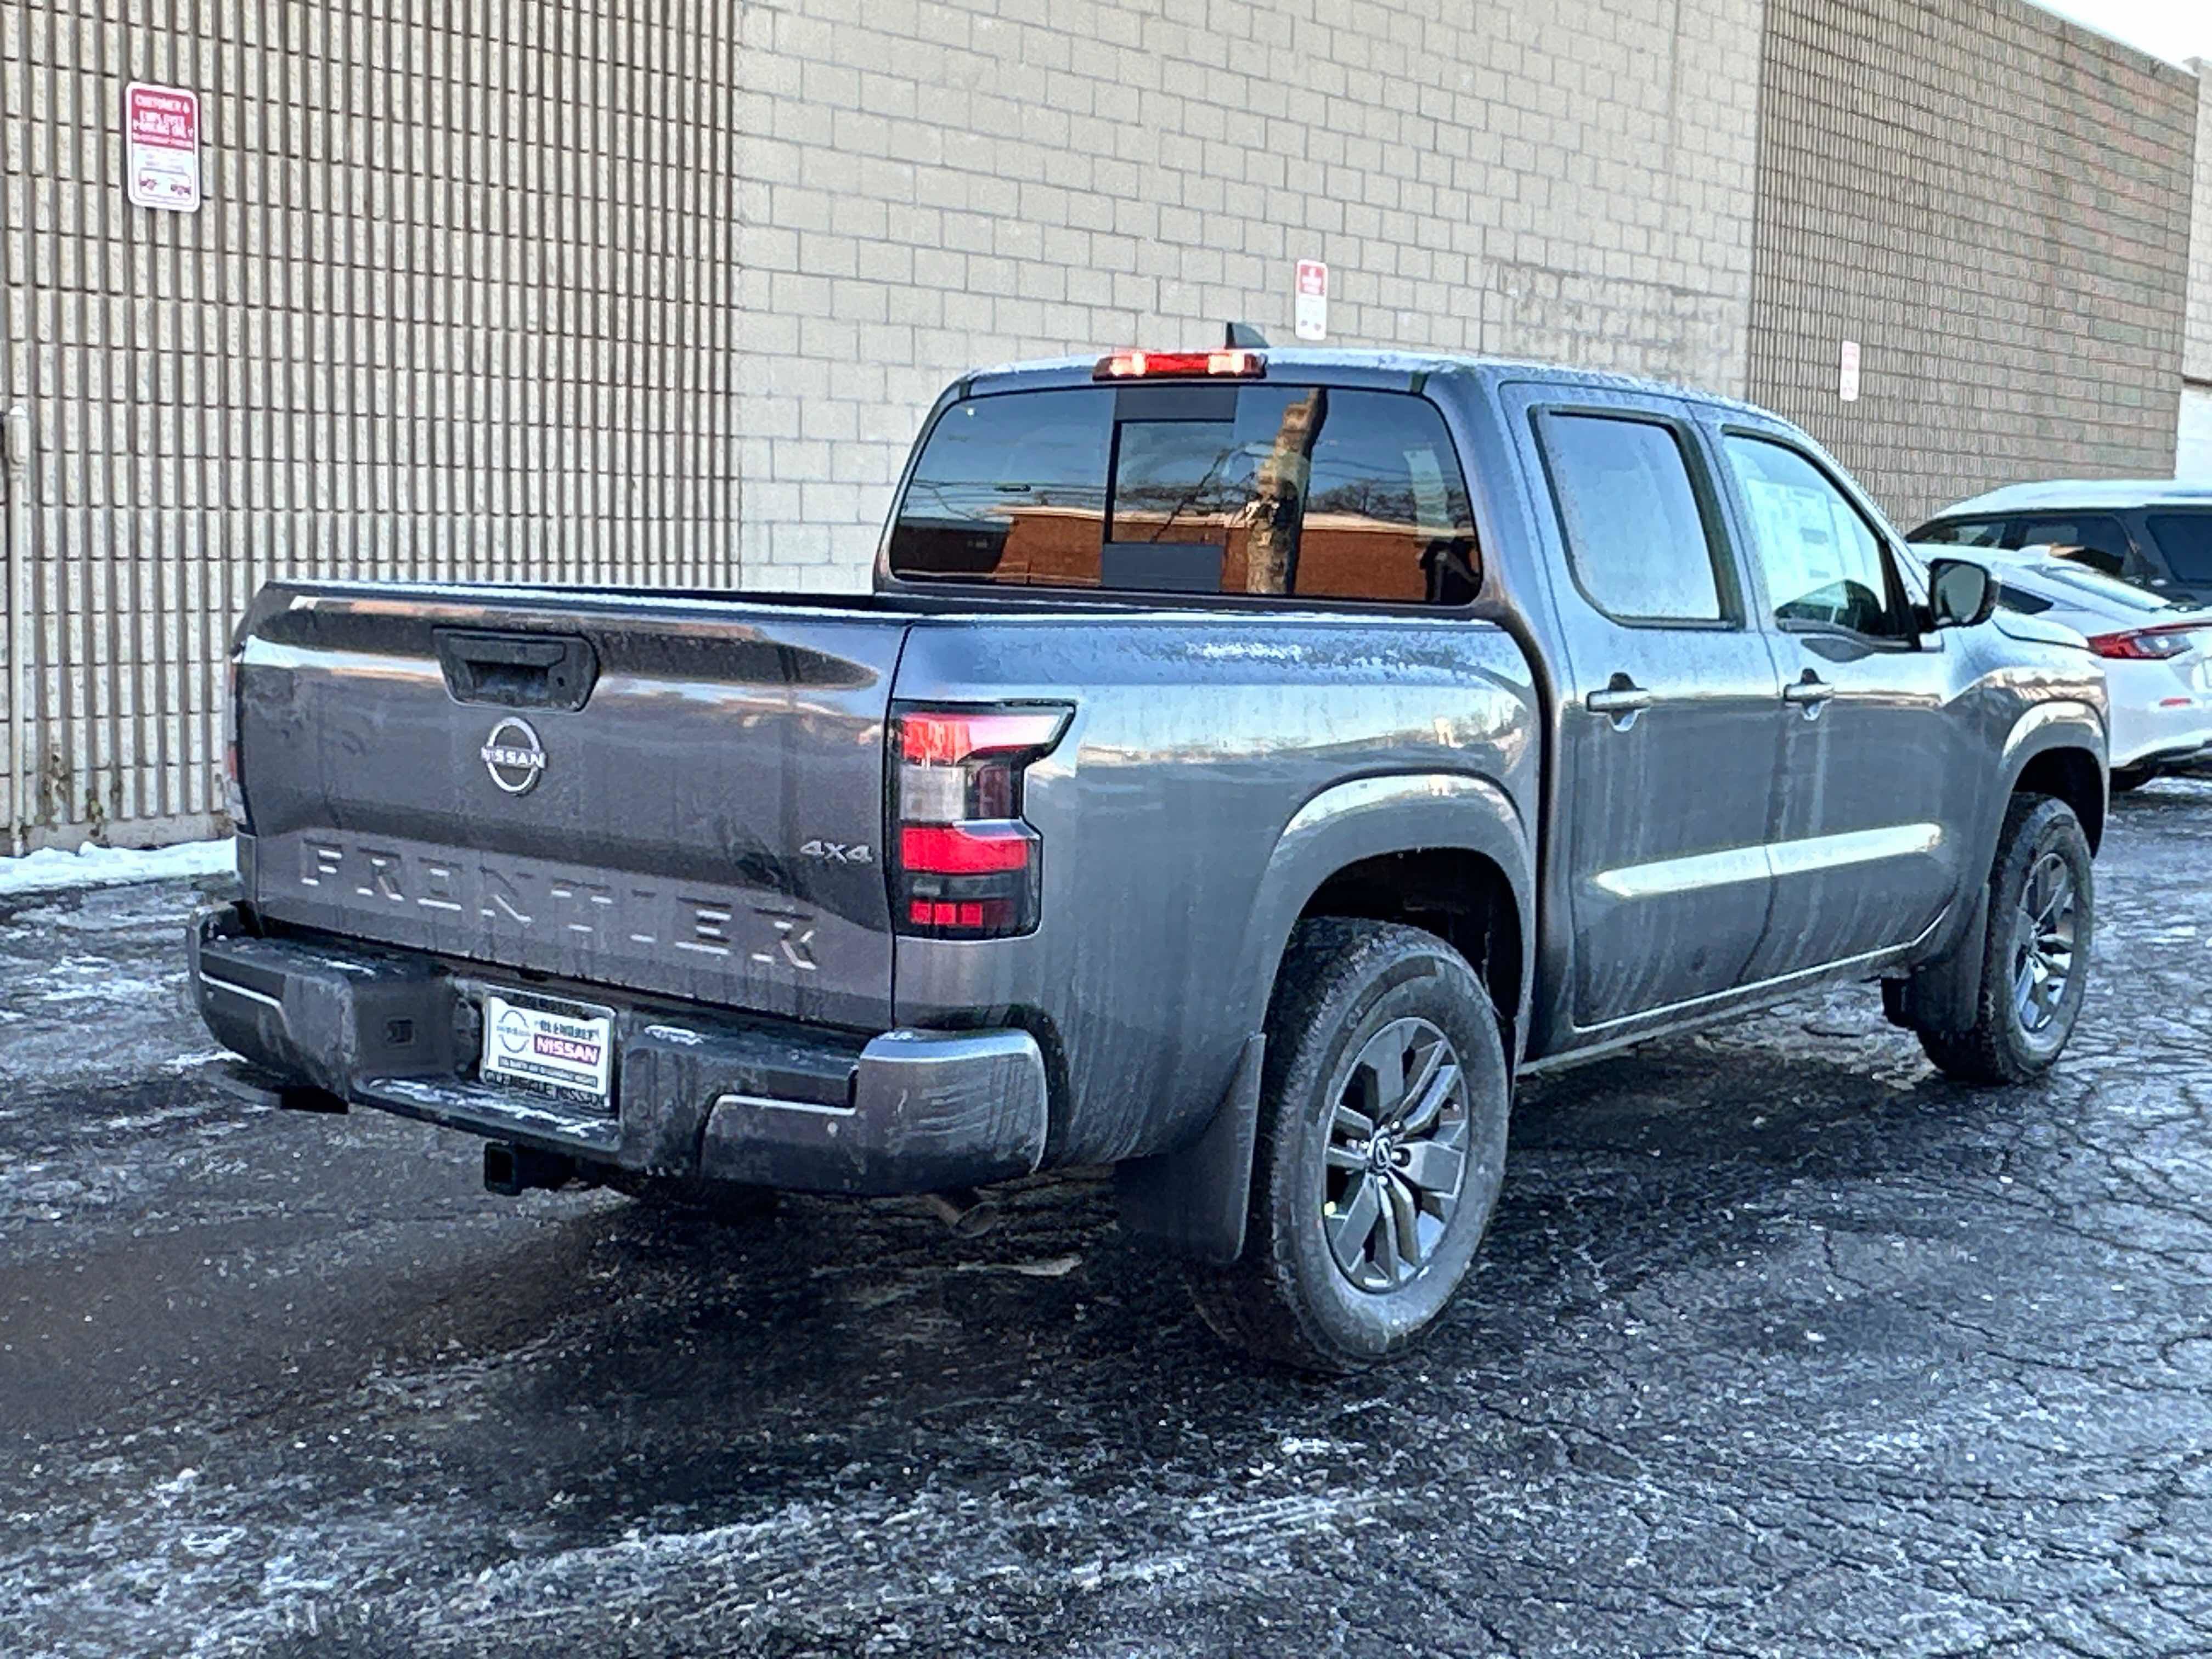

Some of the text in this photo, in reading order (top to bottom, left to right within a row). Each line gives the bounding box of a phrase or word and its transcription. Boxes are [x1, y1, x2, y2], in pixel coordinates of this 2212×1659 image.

[481, 746, 545, 769] NISSAN
[301, 837, 817, 972] FRONTIER
[536, 1036, 598, 1063] NISSAN
